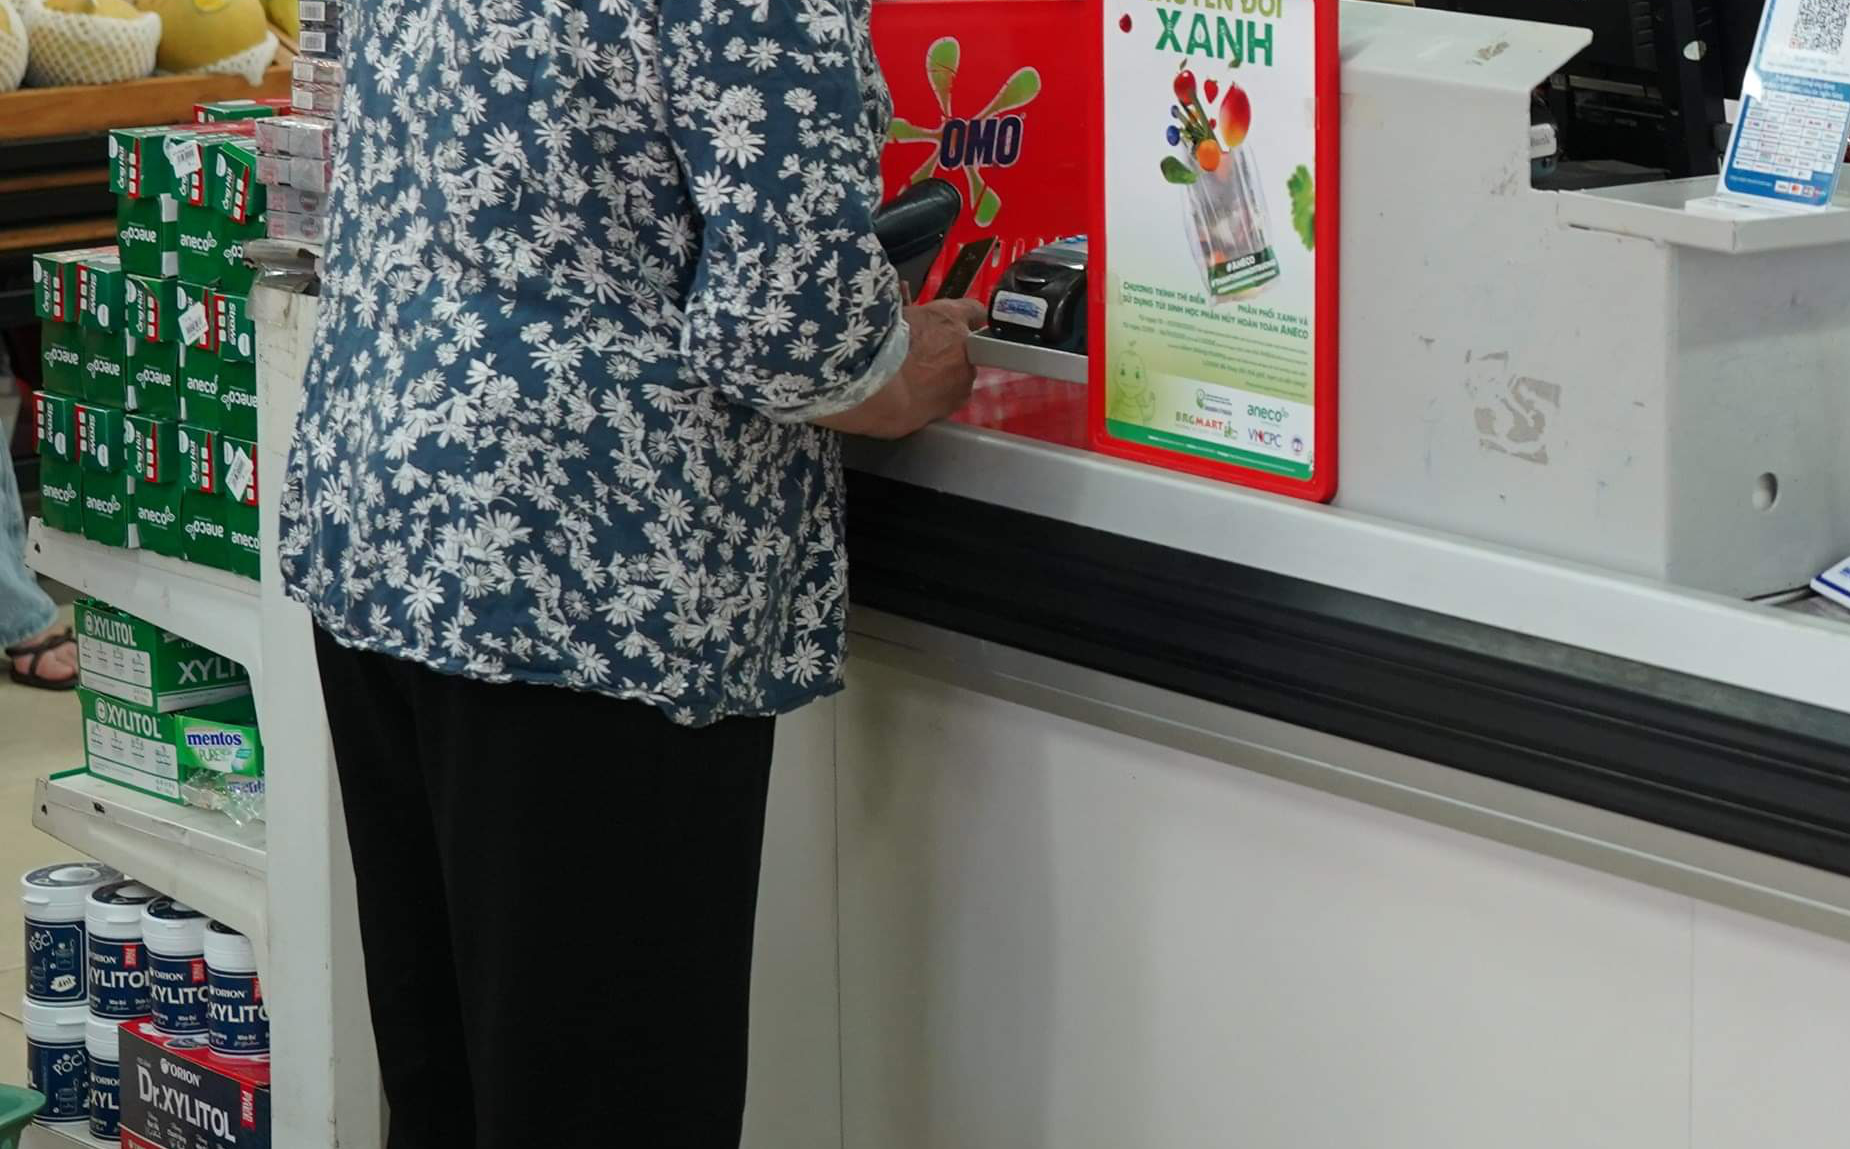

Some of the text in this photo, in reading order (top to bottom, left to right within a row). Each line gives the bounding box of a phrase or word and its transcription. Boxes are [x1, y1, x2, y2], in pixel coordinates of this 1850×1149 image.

[1155, 6, 1274, 68] XANH
[939, 116, 1024, 170] OMO
[127, 226, 158, 244] aneco
[179, 232, 210, 252] aneco
[94, 359, 121, 377] aneco
[143, 369, 172, 387] aneco
[186, 376, 217, 395] aneco
[1247, 403, 1284, 424] aneco
[42, 483, 69, 502] aneco
[86, 495, 113, 515] aneco
[138, 506, 167, 526] aneco
[193, 520, 225, 538] aneco
[231, 531, 260, 549] aneco
[93, 613, 138, 647] XYLITOL
[177, 656, 249, 686] XYLI
[106, 701, 163, 740] XYLITOL
[185, 731, 243, 747] mentos
[150, 986, 208, 1005] XYLITO
[207, 1004, 269, 1024] XYLITO
[169, 1063, 201, 1088] ORION
[136, 1064, 237, 1144] Dr.XYLITOL
